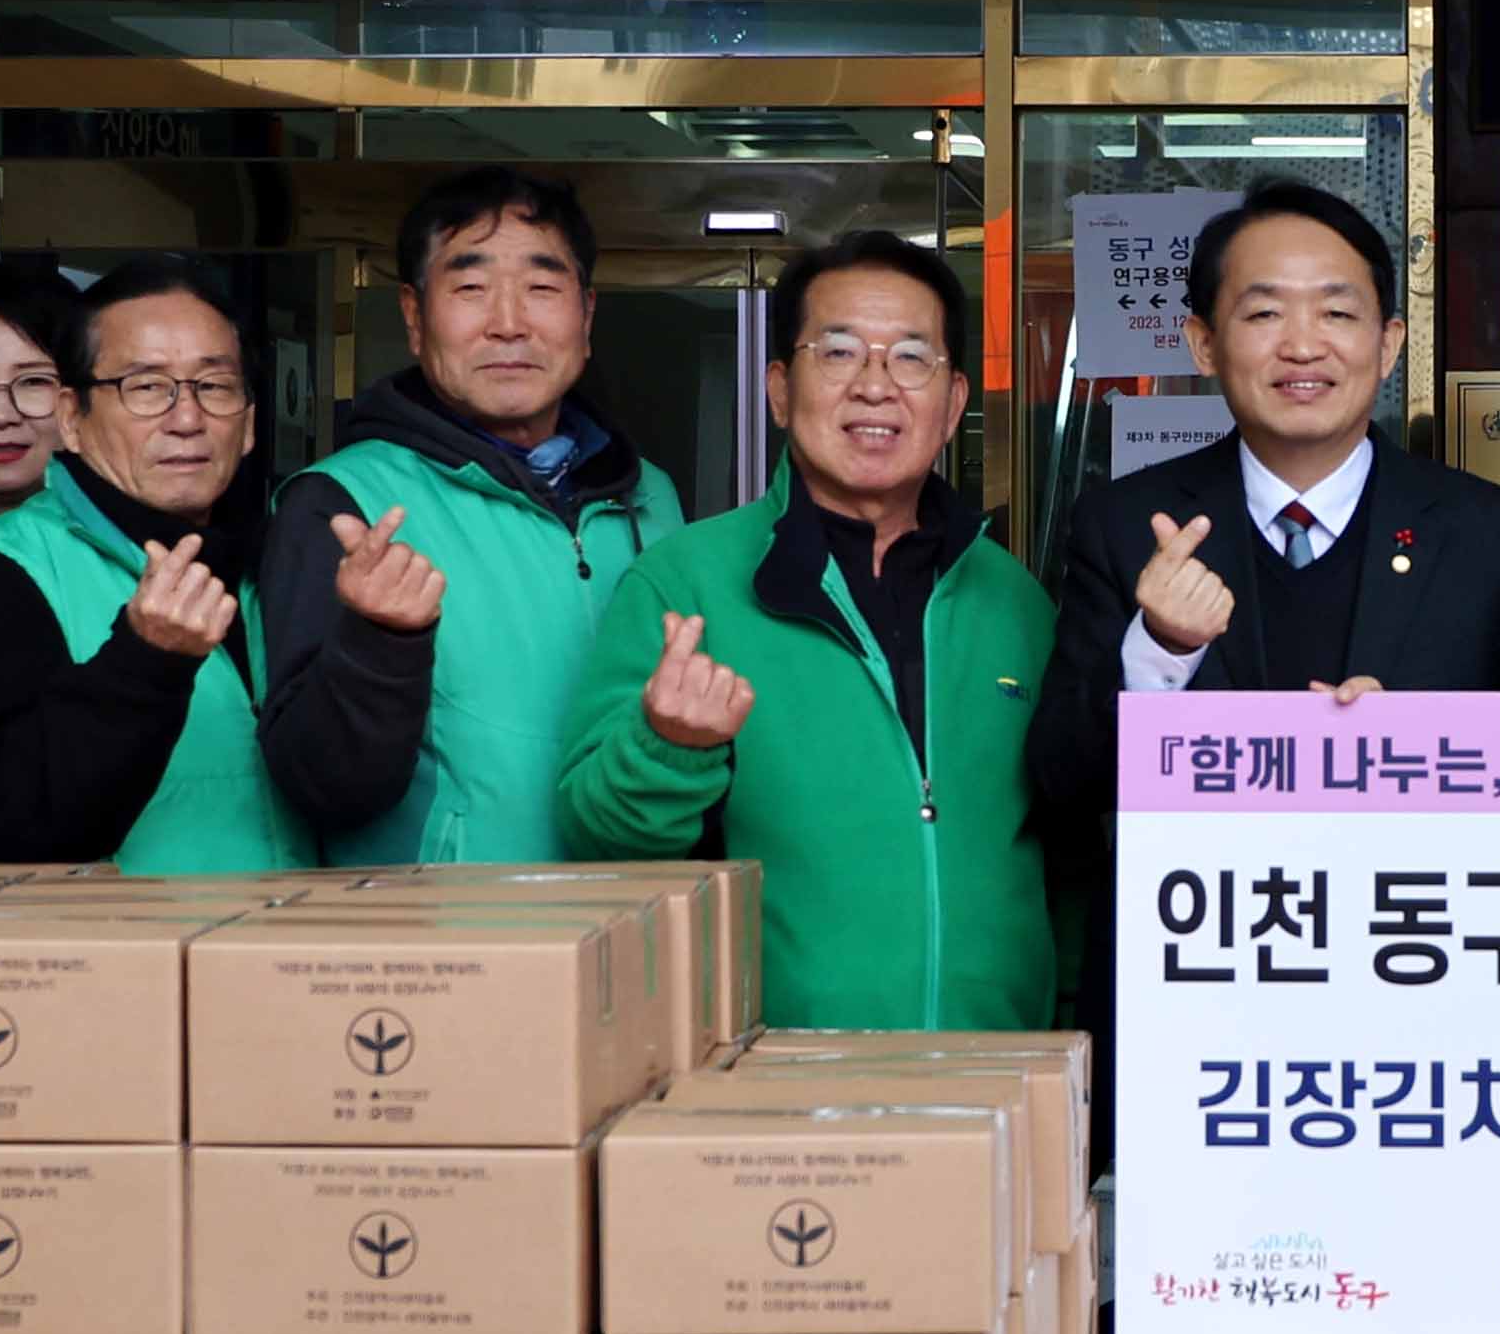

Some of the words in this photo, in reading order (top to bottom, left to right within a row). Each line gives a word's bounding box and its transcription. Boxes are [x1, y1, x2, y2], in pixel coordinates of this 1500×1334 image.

[1107, 237, 1154, 262] 동구
[1128, 316, 1165, 330] 2023.
[1157, 867, 1330, 986] 인천
[1213, 1252, 1246, 1271] 살고
[1251, 1252, 1282, 1271] 싶은
[1288, 1252, 1327, 1271] 도시!
[1151, 1273, 1221, 1306] 활기찬
[1229, 1276, 1320, 1307] 행복도시
[1325, 1272, 1390, 1310] 동구
